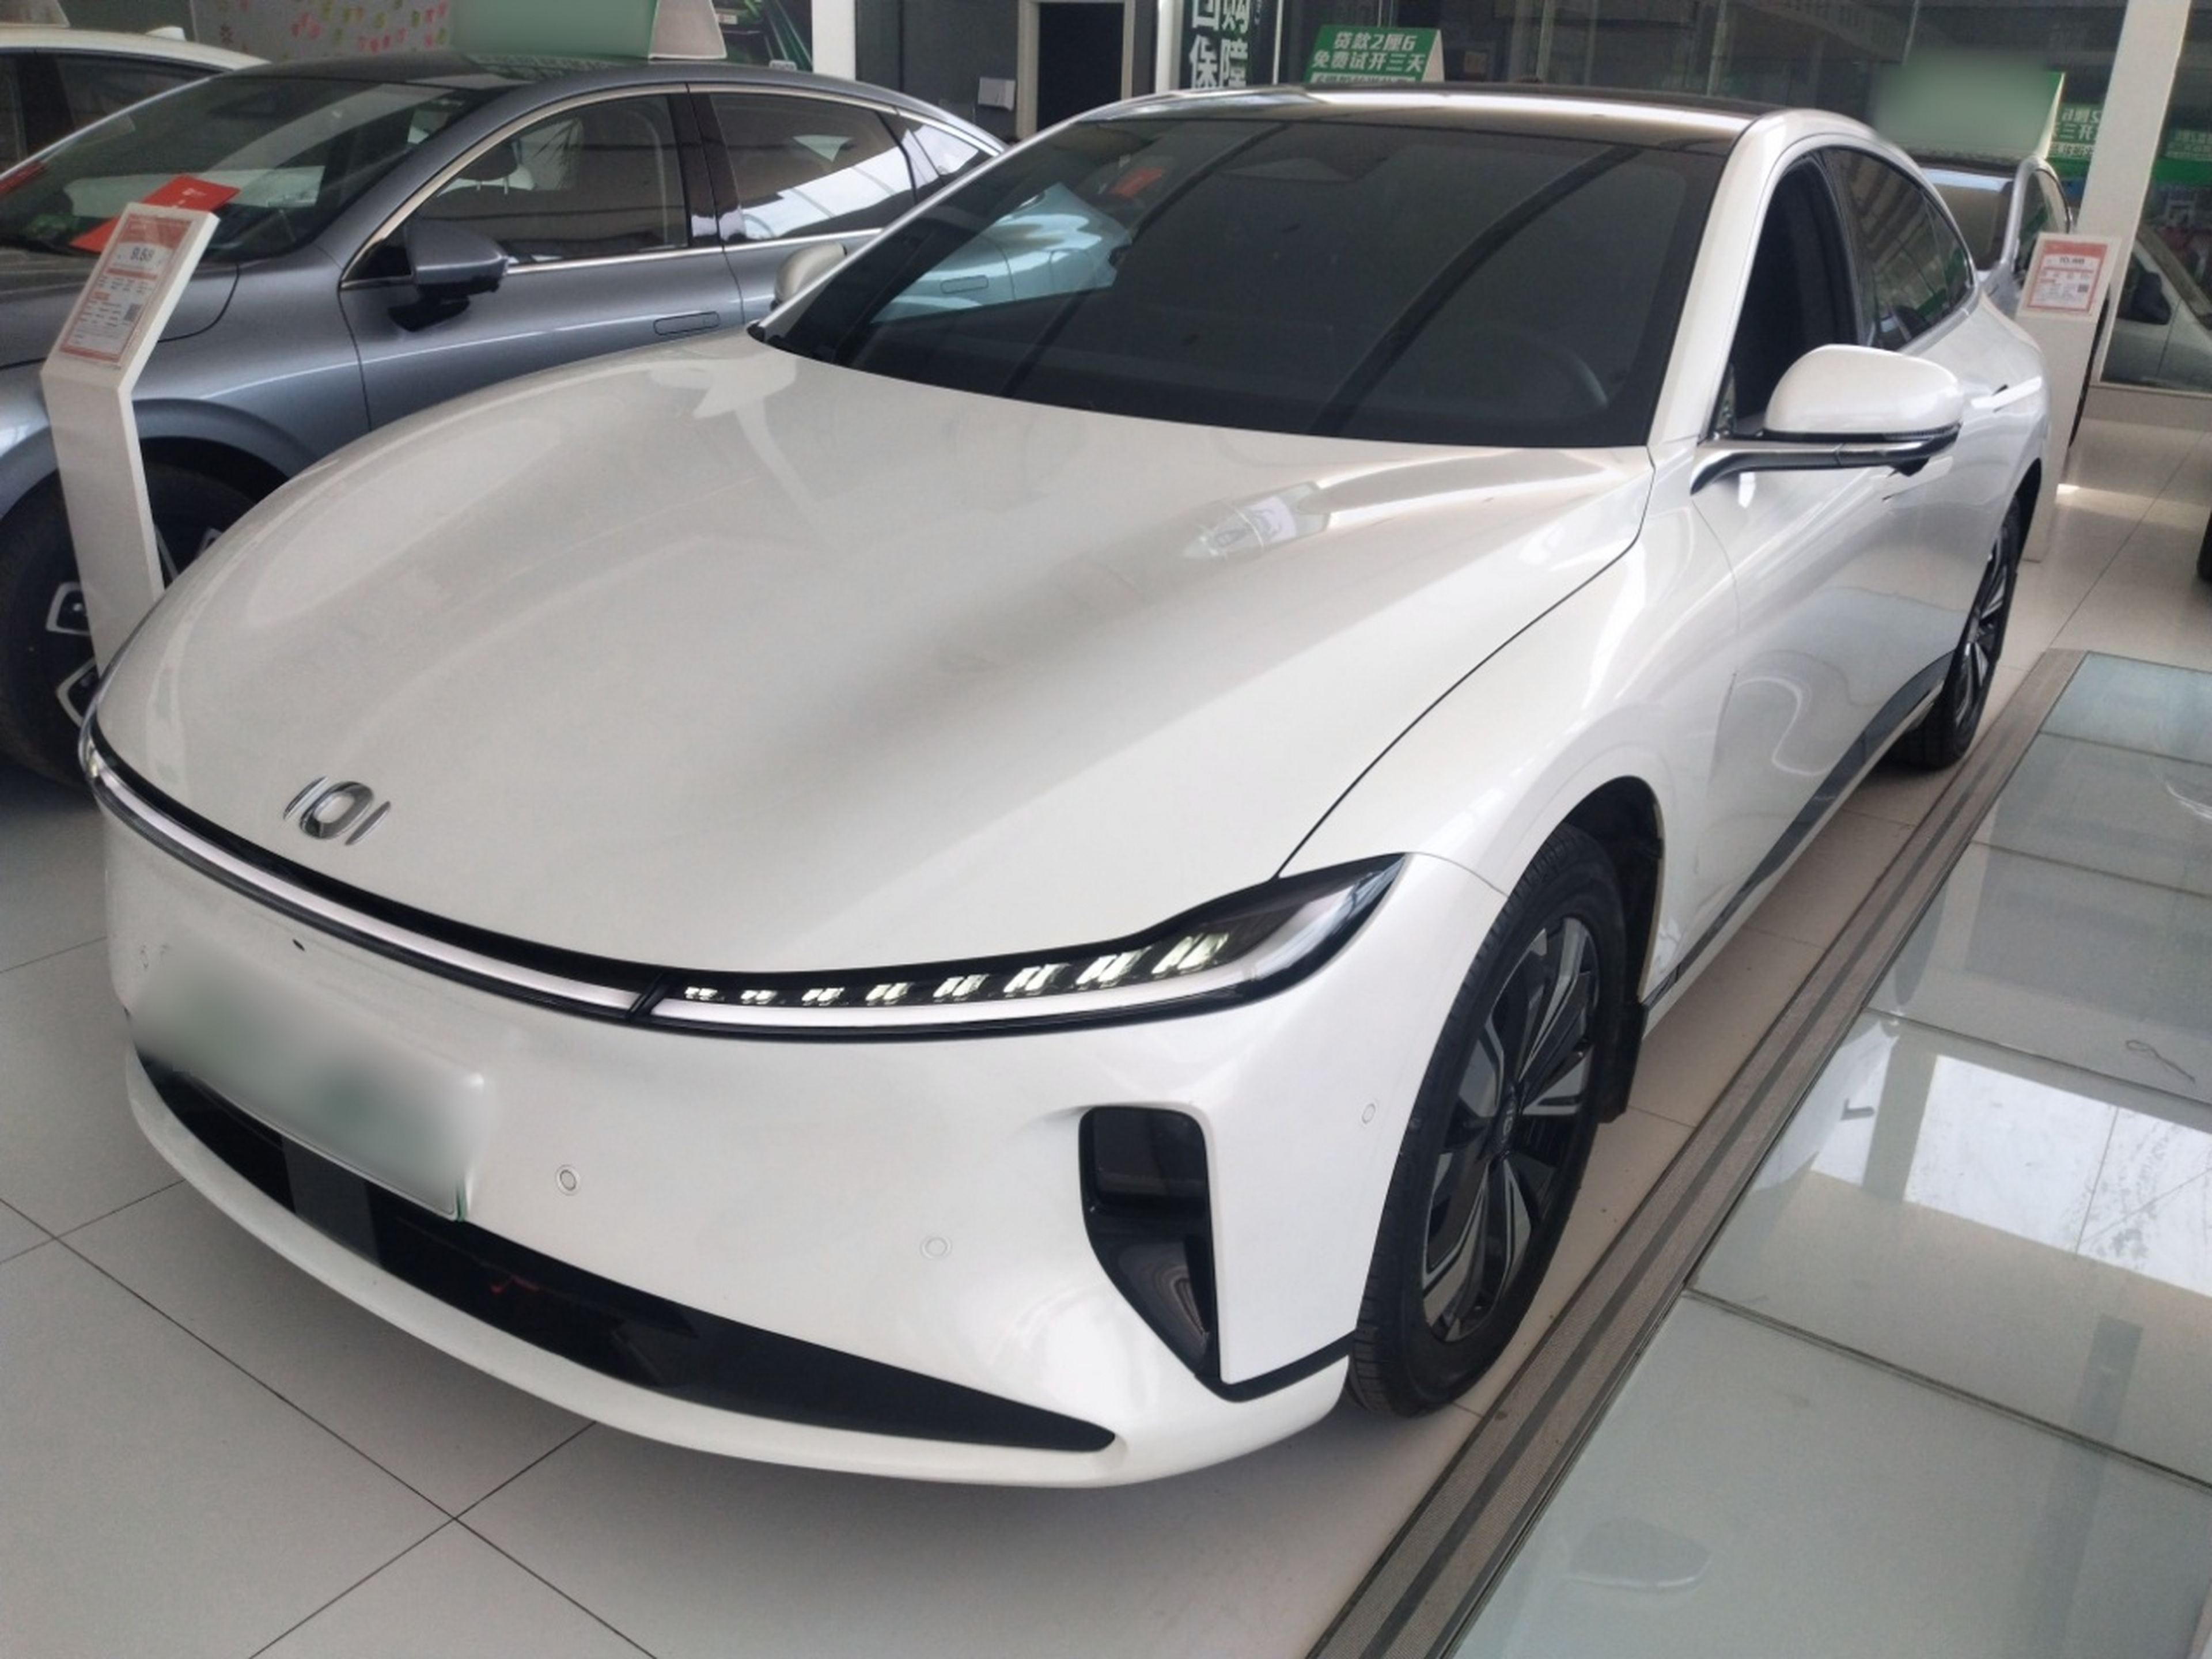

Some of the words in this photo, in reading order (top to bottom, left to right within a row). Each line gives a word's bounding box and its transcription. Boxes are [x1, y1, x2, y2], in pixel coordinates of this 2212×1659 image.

[1189, 34, 1249, 89] 保障
[1312, 50, 1425, 71] 免费试开三天
